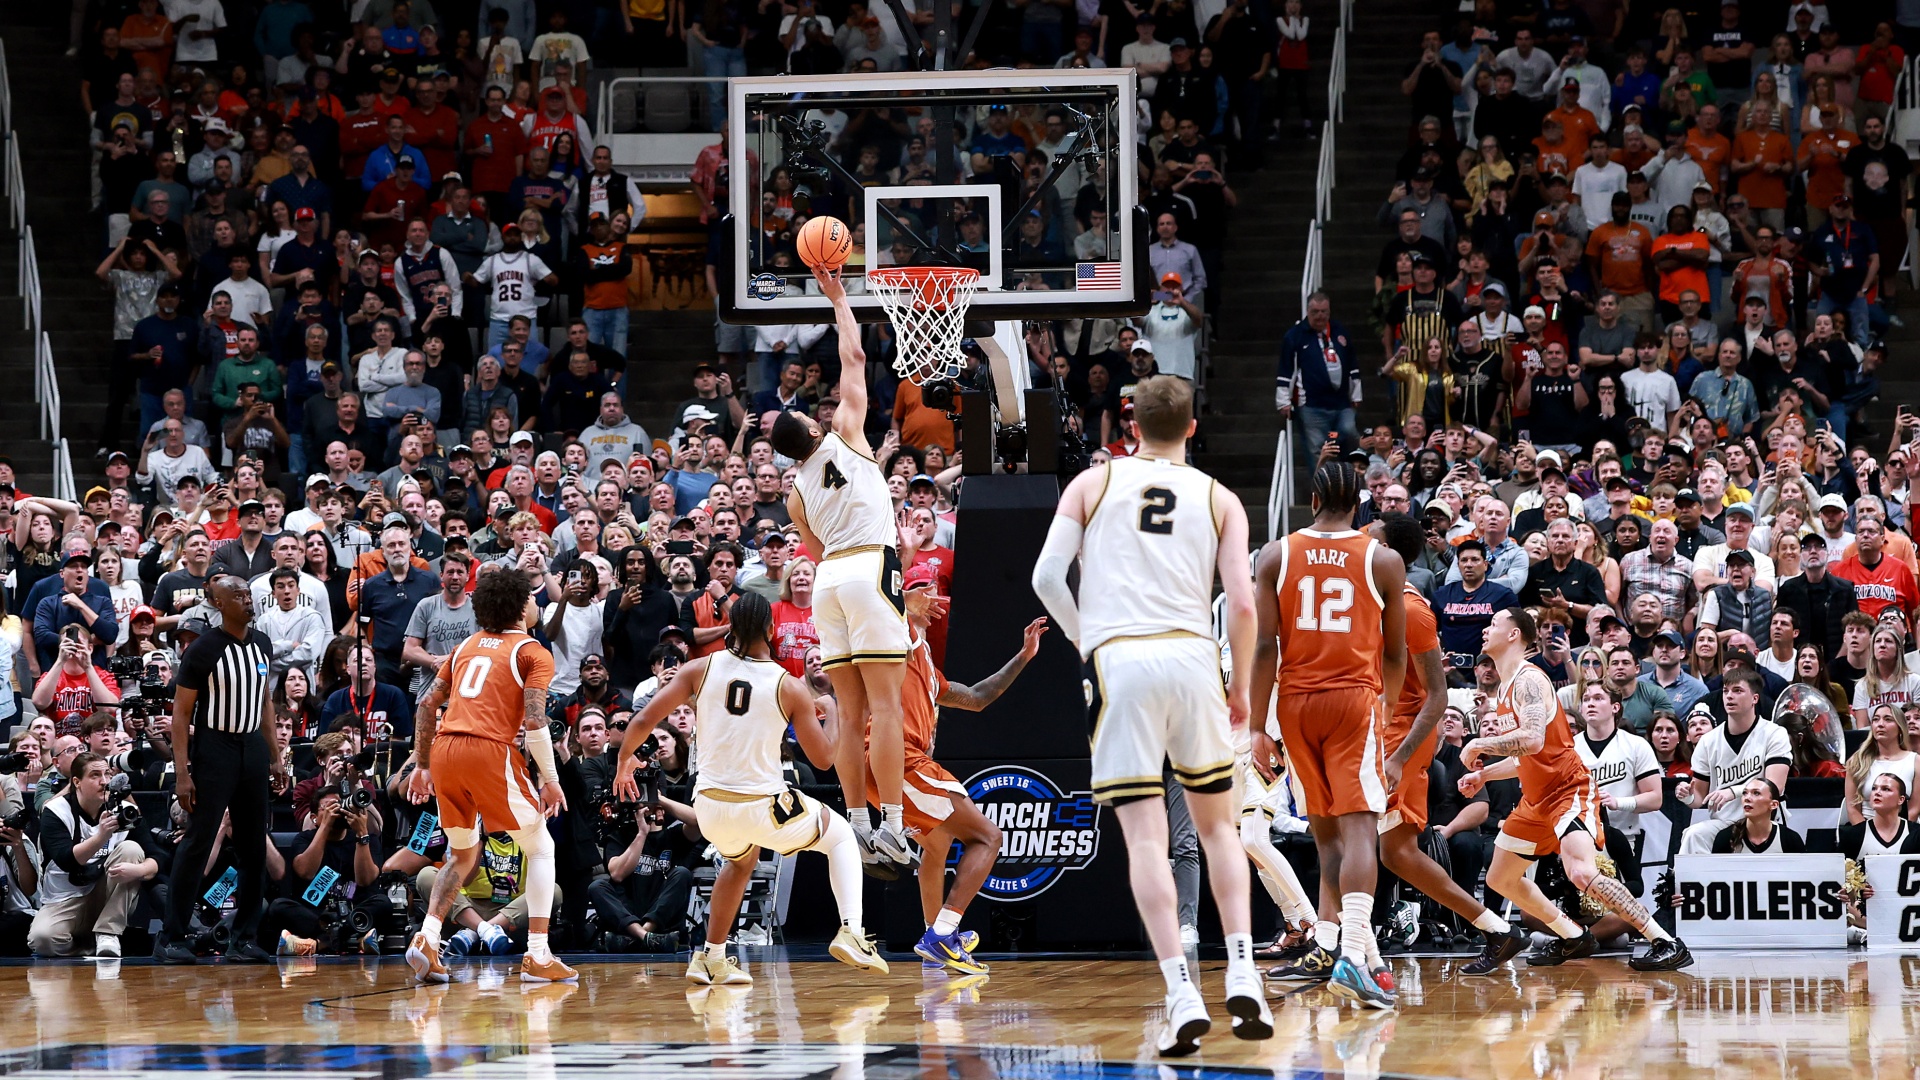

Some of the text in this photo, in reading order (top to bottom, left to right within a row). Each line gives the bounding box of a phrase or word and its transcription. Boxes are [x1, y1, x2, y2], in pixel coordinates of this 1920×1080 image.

[496, 269, 524, 284] ARIZONA
[499, 283, 521, 302] 25
[590, 434, 628, 446] PURDUE
[822, 460, 848, 490] 4
[1137, 484, 1177, 535] 2
[1305, 548, 1349, 568] MARK
[260, 592, 312, 610] PUUE
[1295, 575, 1356, 633] 12
[1443, 602, 1494, 615] ARIZONA
[431, 619, 470, 633] Strand
[435, 629, 471, 642] Books
[478, 637, 504, 649] POPE
[459, 655, 492, 699] 0
[726, 679, 753, 716] 0
[1869, 691, 1913, 708] ARIZONA
[1592, 760, 1626, 783] rdue
[1715, 755, 1762, 785] Purdue
[981, 776, 1029, 792] SWEET 16
[417, 813, 434, 840] CHAMP
[999, 829, 1094, 857] ADNESS
[314, 867, 337, 892] CHAMP
[989, 877, 1028, 891] ELITE 8
[1680, 881, 1844, 921] BOILERS
